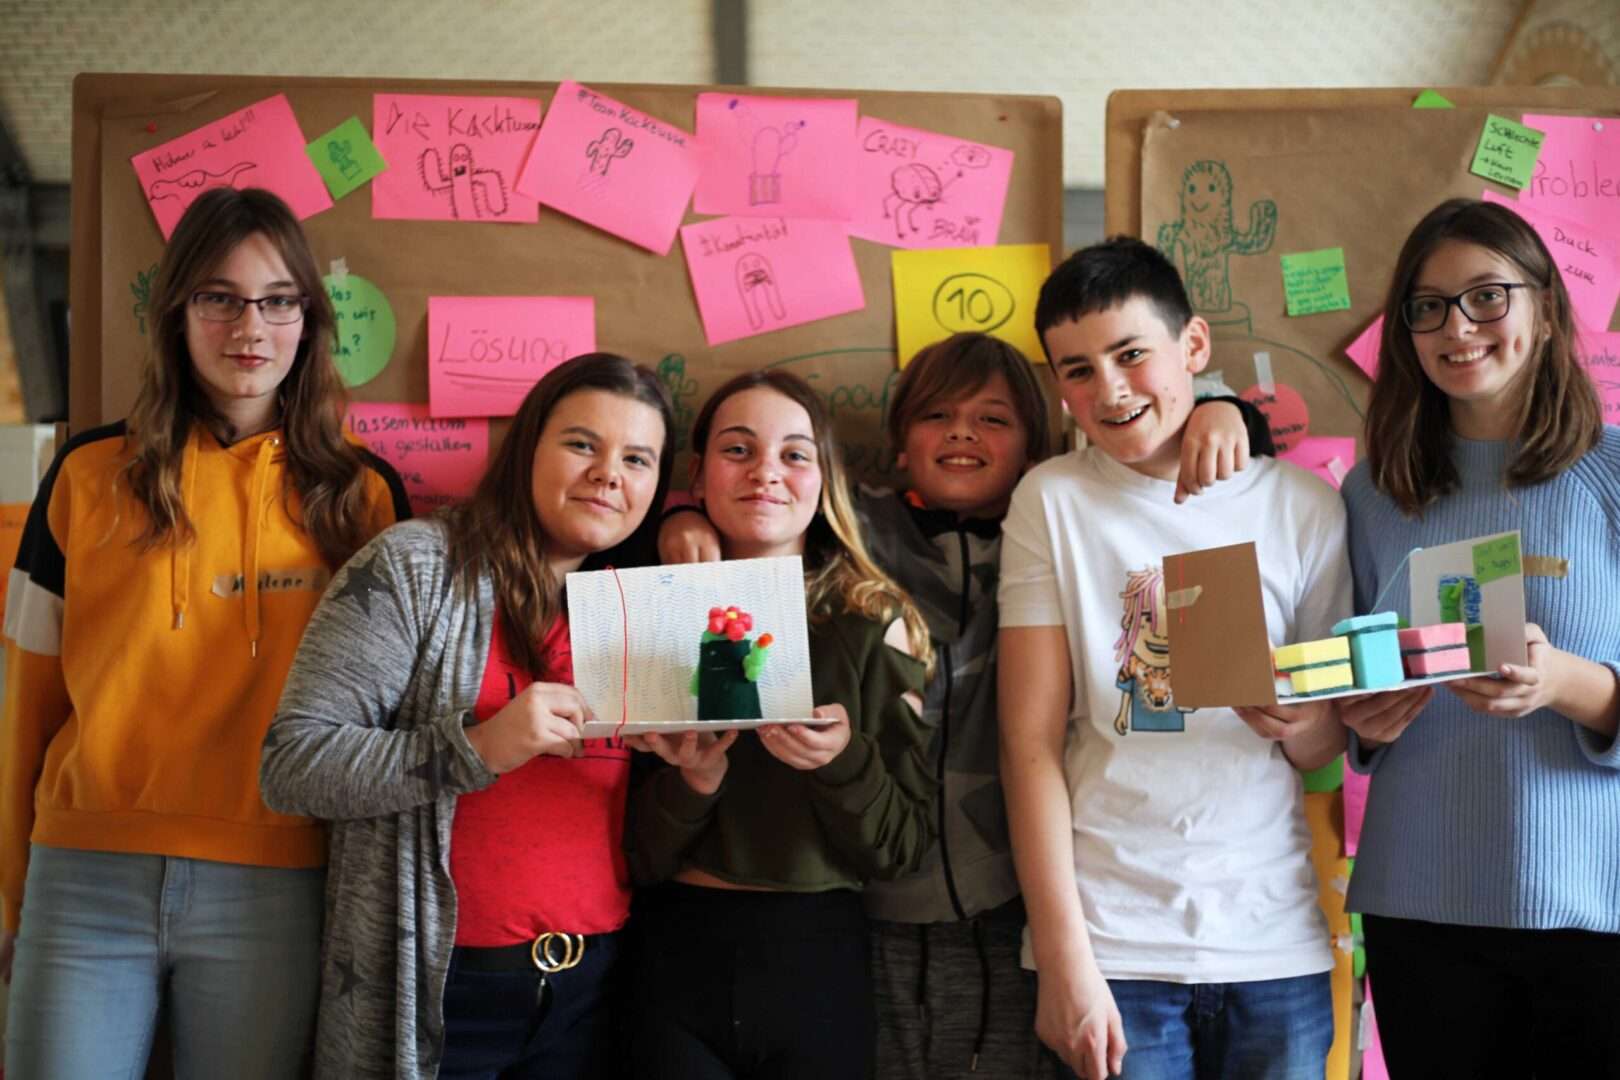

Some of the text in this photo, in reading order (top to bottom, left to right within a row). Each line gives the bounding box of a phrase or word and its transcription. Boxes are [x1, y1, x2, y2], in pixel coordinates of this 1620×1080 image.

[1530, 160, 1620, 198] Proble
[945, 287, 995, 324] 10
[350, 415, 466, 433] lassenraum
